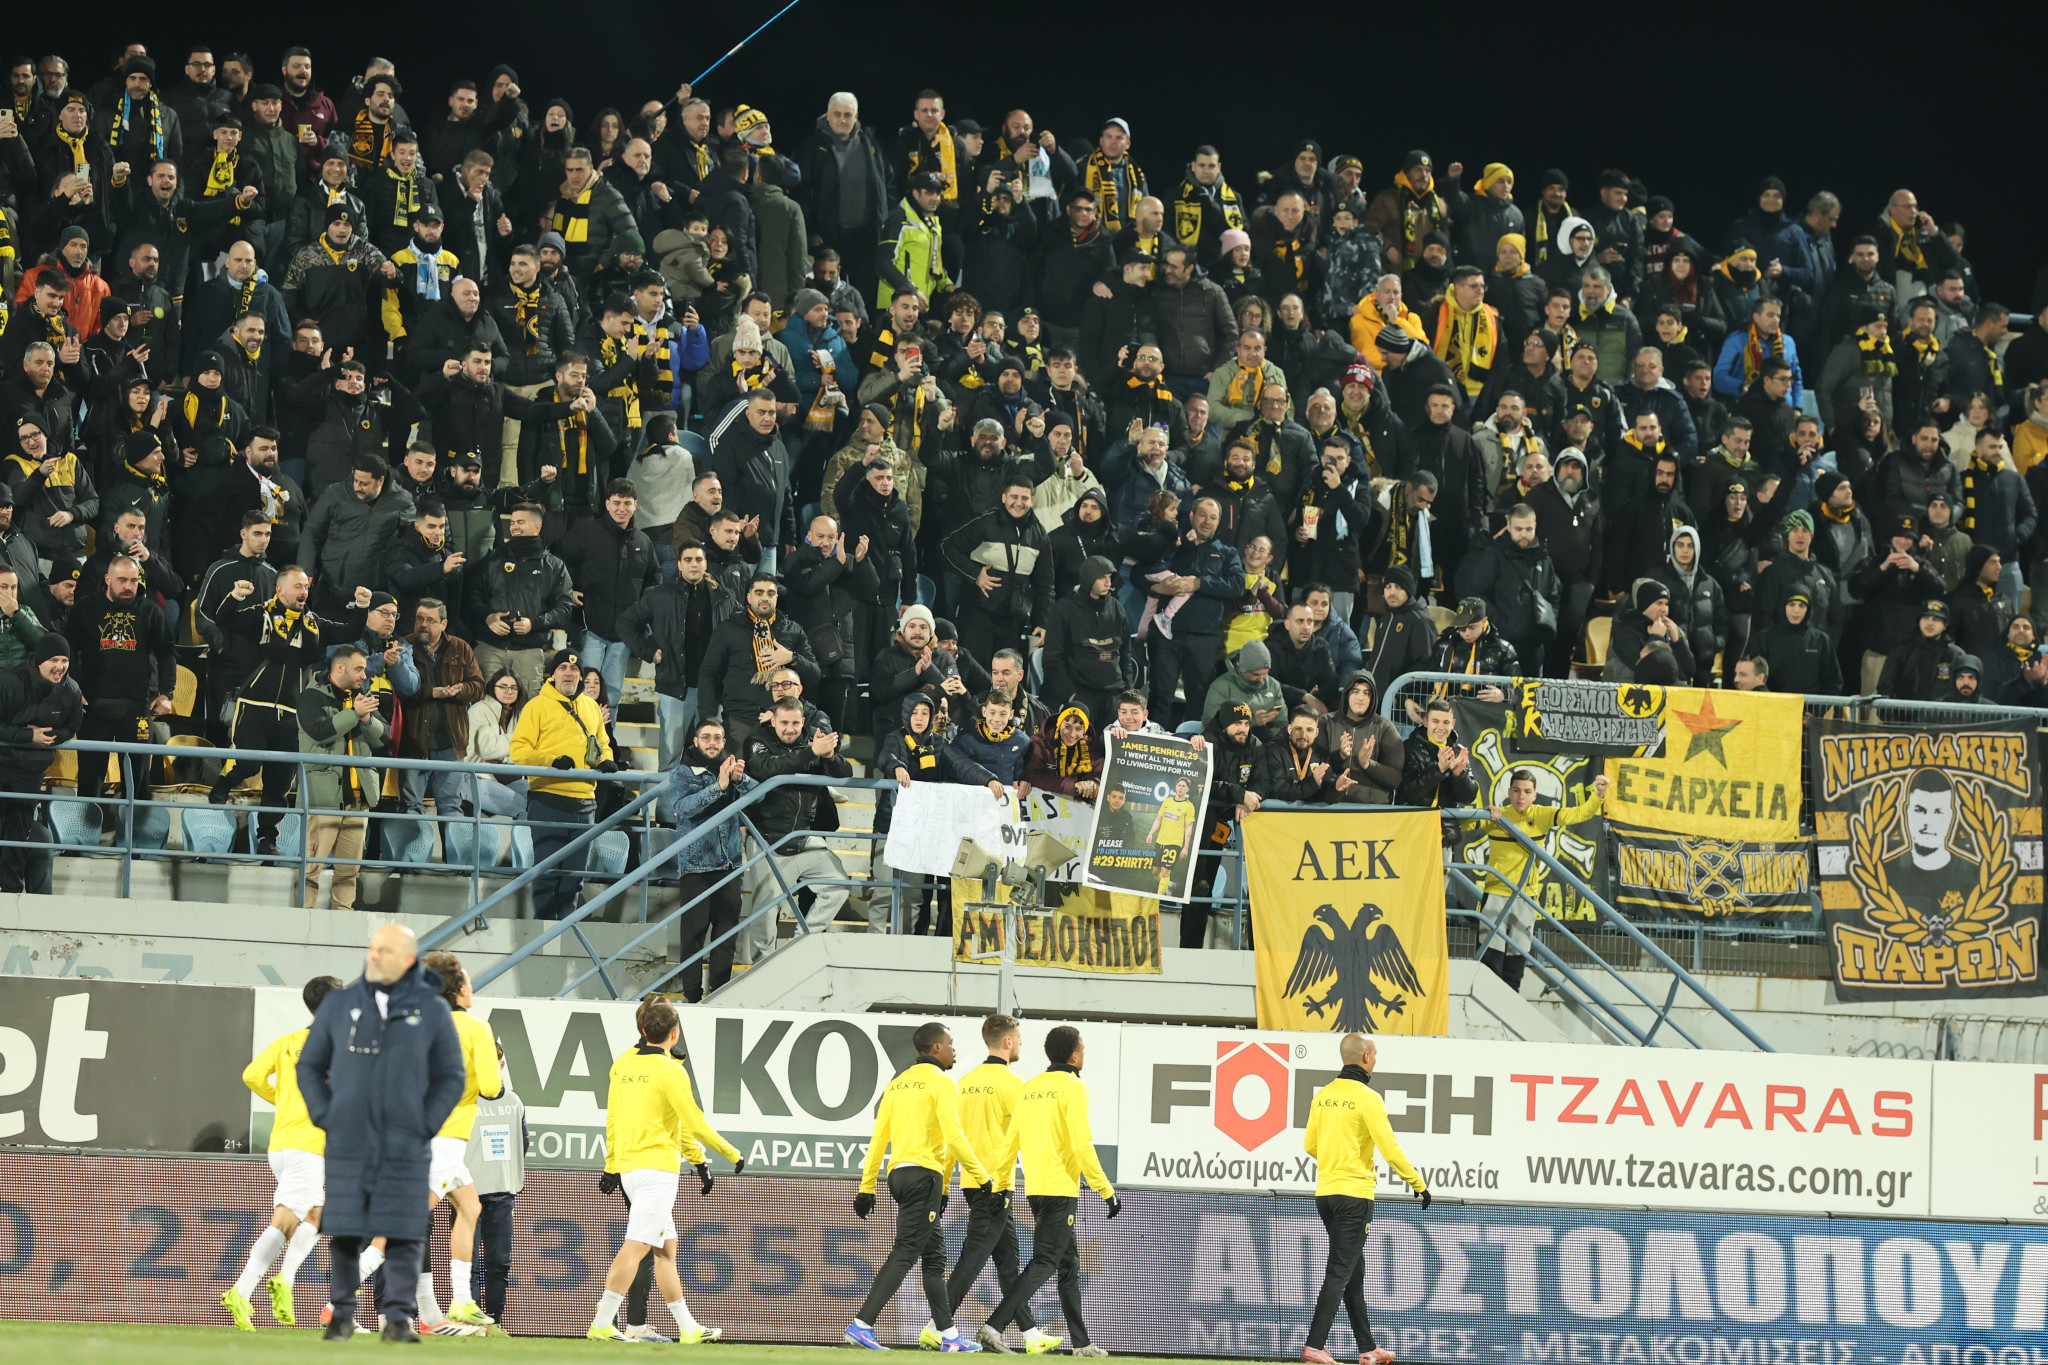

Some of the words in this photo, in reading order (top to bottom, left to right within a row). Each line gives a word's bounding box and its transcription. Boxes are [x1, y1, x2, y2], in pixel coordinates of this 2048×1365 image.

[1120, 741, 1149, 753] JAMES
[1128, 751, 1149, 762] WENT
[1148, 754, 1162, 763] ALL
[1162, 756, 1176, 766] THE
[1176, 759, 1192, 768] WAY
[1821, 732, 2030, 800] ΝΙΚΟΛΑΚΗΣ
[1116, 758, 1126, 766] TO
[1126, 760, 1167, 773] LIVINGSTON
[1167, 766, 1182, 775] FOR
[1182, 768, 1199, 778] YOU!
[1122, 780, 1147, 792] Welcome
[1616, 763, 1788, 822] ΕΞΑΡΧΕΙΑ
[1098, 839, 1124, 848] PLEASE
[1092, 855, 1115, 866] #29
[1115, 856, 1153, 870] SHIRT?!
[1161, 848, 1177, 864] 29
[1292, 839, 1400, 881] ΑΕΚ
[1834, 918, 2039, 988] ΠΑΡΩΝ
[912, 1081, 926, 1090] FC
[982, 1086, 994, 1095] FC
[1046, 1091, 1058, 1099] FC
[476, 1105, 496, 1117] ALL
[497, 1104, 518, 1116] BOY
[1342, 1100, 1356, 1109] FC
[1510, 1074, 1914, 1138] TZAVARAS
[224, 1139, 242, 1149] 21+
[1526, 1152, 1912, 1208] www.tzavaras.com.gr
